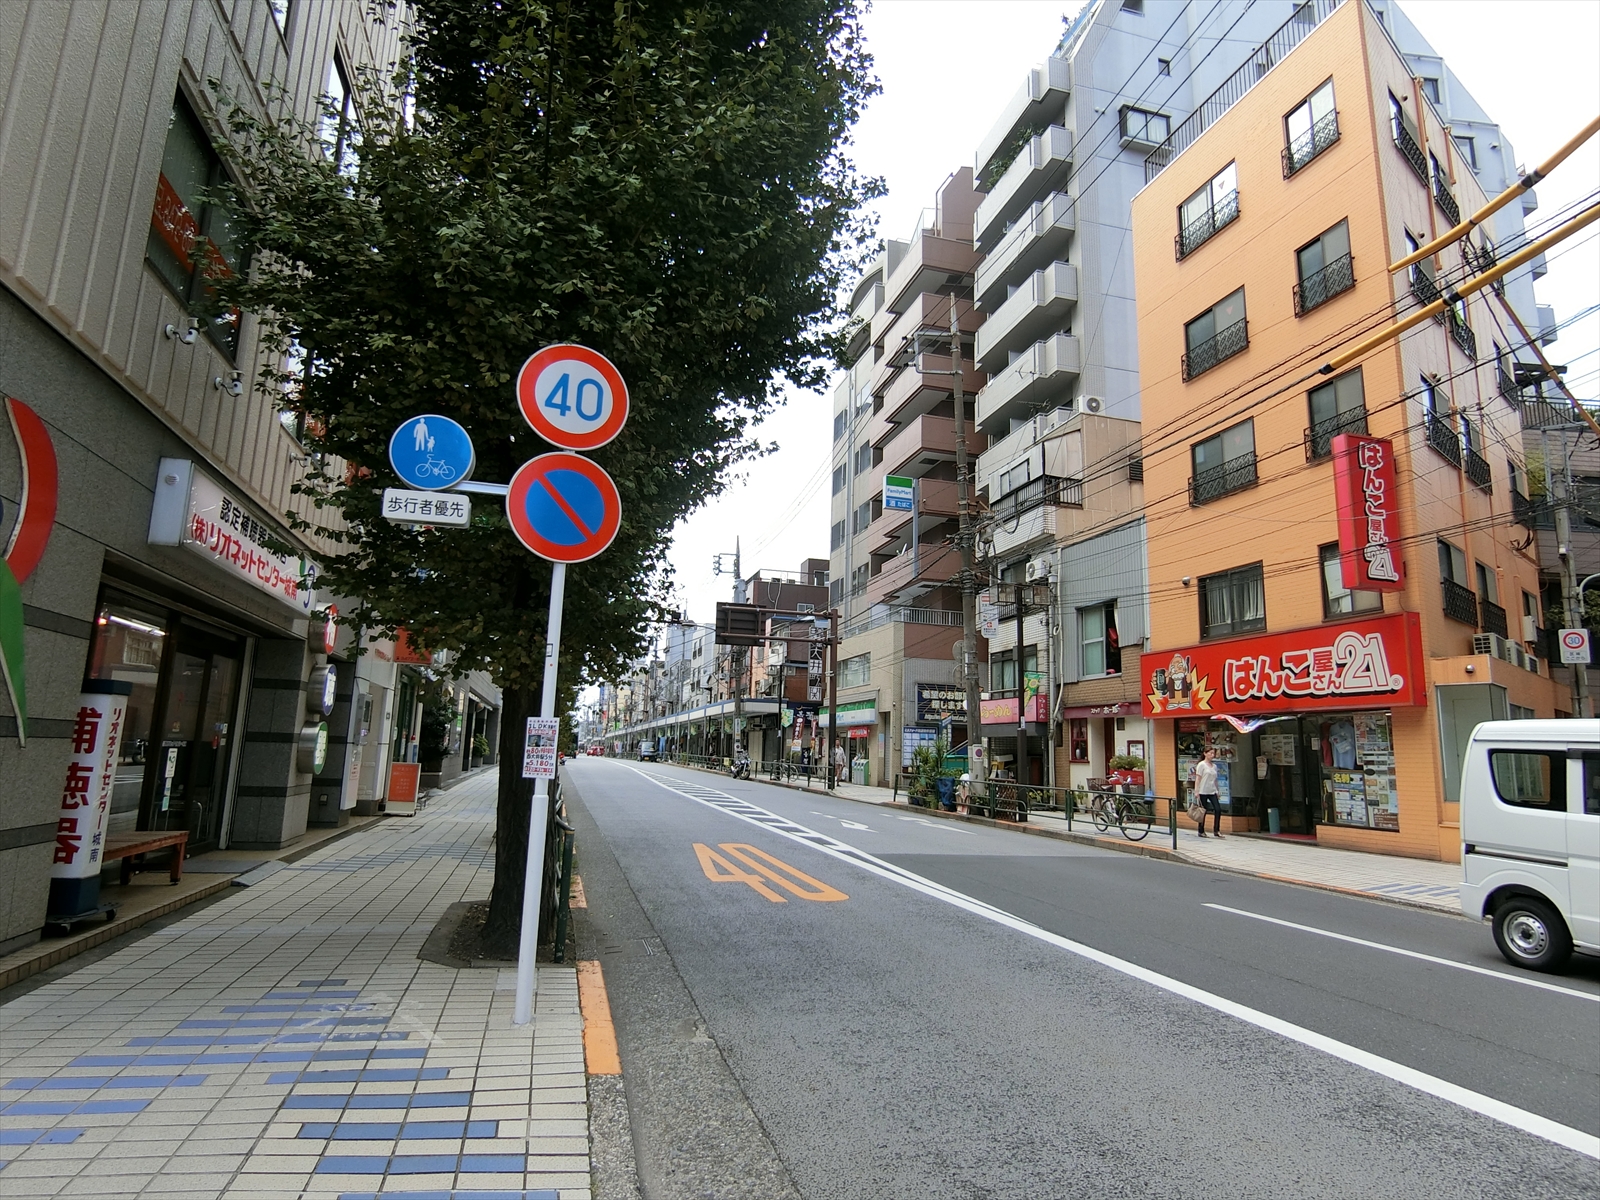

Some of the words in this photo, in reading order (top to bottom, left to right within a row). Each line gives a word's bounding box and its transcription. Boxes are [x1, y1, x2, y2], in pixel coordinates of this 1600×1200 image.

[544, 373, 604, 422] 40
[387, 496, 464, 518] 歩行者優先
[888, 487, 911, 496] FamilyMart
[1358, 442, 1396, 581] はんこ屋さん21
[219, 496, 288, 566] 認定補聴器
[1225, 630, 1393, 700] はんこ屋さん21
[1568, 637, 1579, 645] 30
[981, 704, 1011, 719] らーめん
[692, 843, 850, 903] 40
